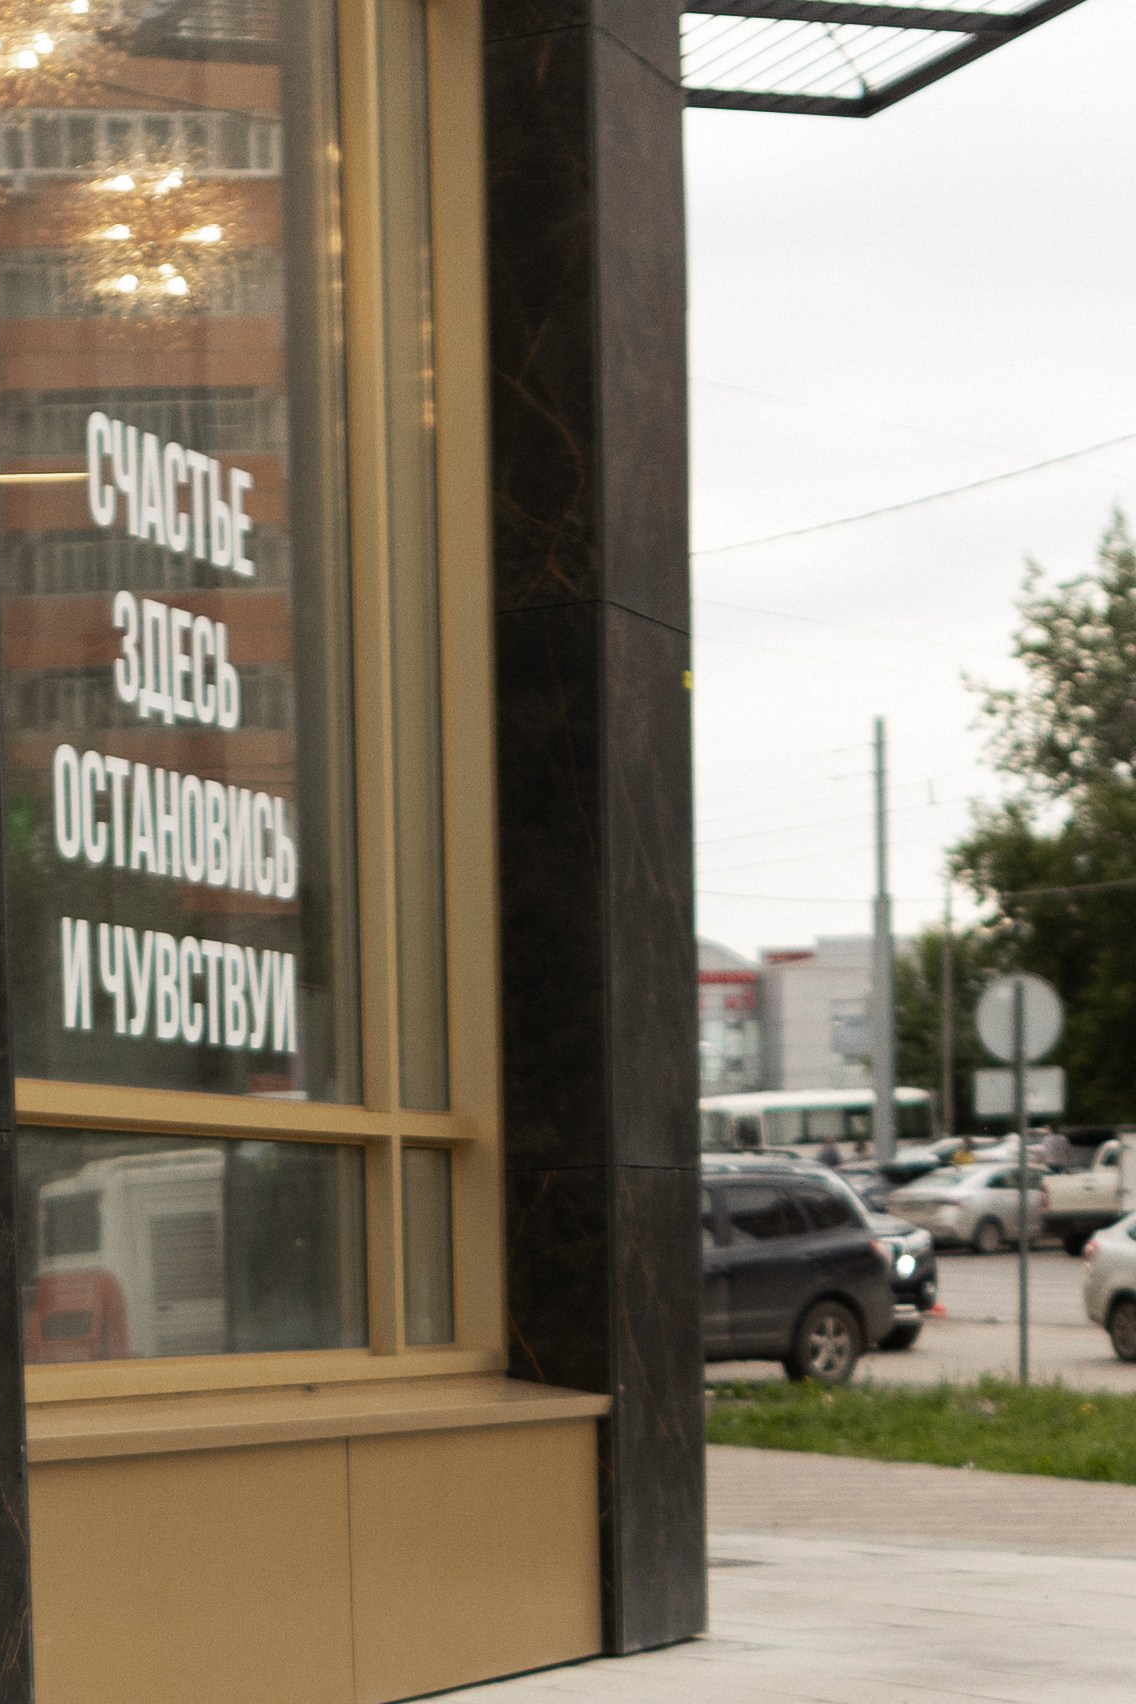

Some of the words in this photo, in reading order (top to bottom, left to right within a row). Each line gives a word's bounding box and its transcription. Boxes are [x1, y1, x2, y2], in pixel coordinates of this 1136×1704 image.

[87, 411, 255, 577] СЧАСТЬЕ
[113, 590, 240, 730] ЗДЕСЬ
[54, 744, 297, 899] ОСТАНОВИСЬ
[61, 916, 92, 1030] И
